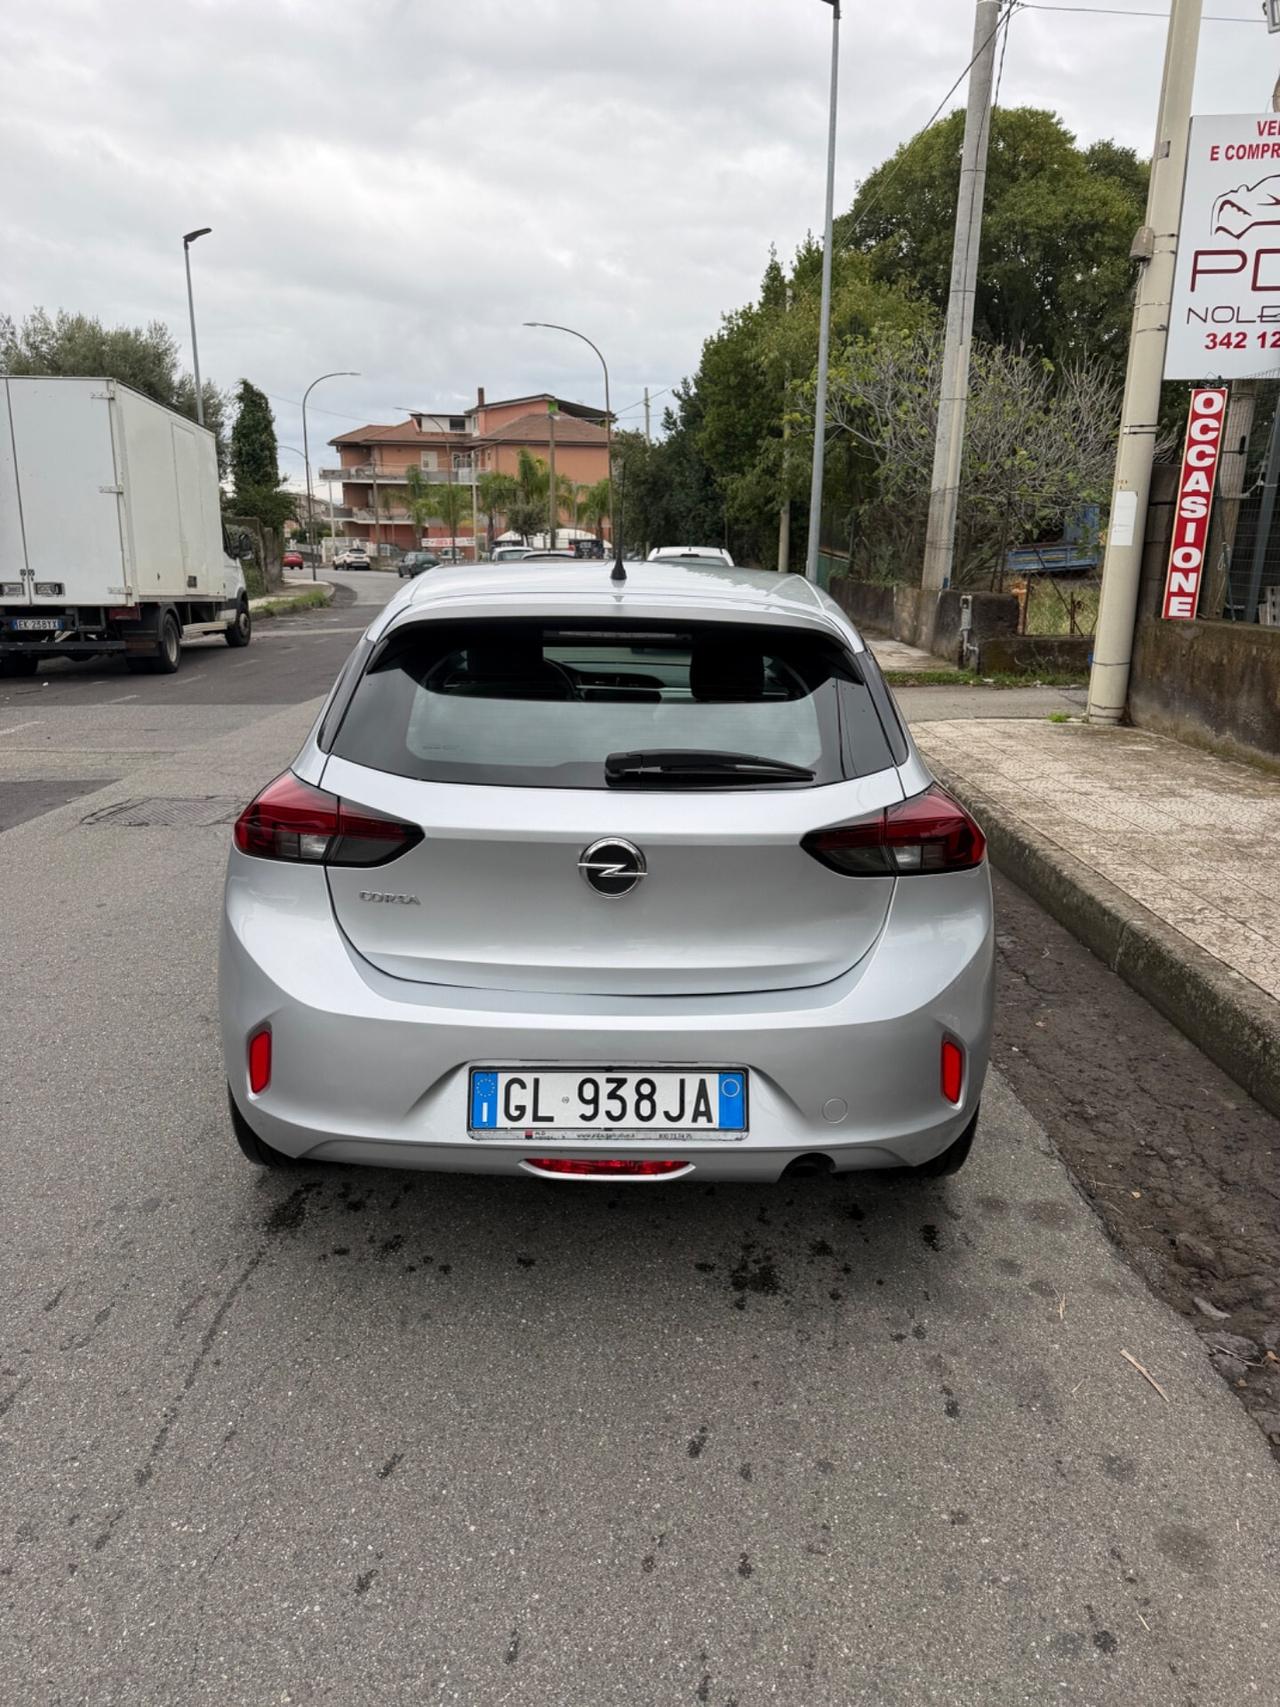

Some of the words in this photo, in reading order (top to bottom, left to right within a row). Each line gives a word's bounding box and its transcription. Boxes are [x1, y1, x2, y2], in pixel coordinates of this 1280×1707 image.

[1257, 120, 1280, 137] VE
[1210, 145, 1220, 161] E
[1204, 331, 1248, 350] 342
[1256, 330, 1280, 349] 12
[1168, 391, 1225, 618] OCCASIONE
[504, 1077, 554, 1123] GL
